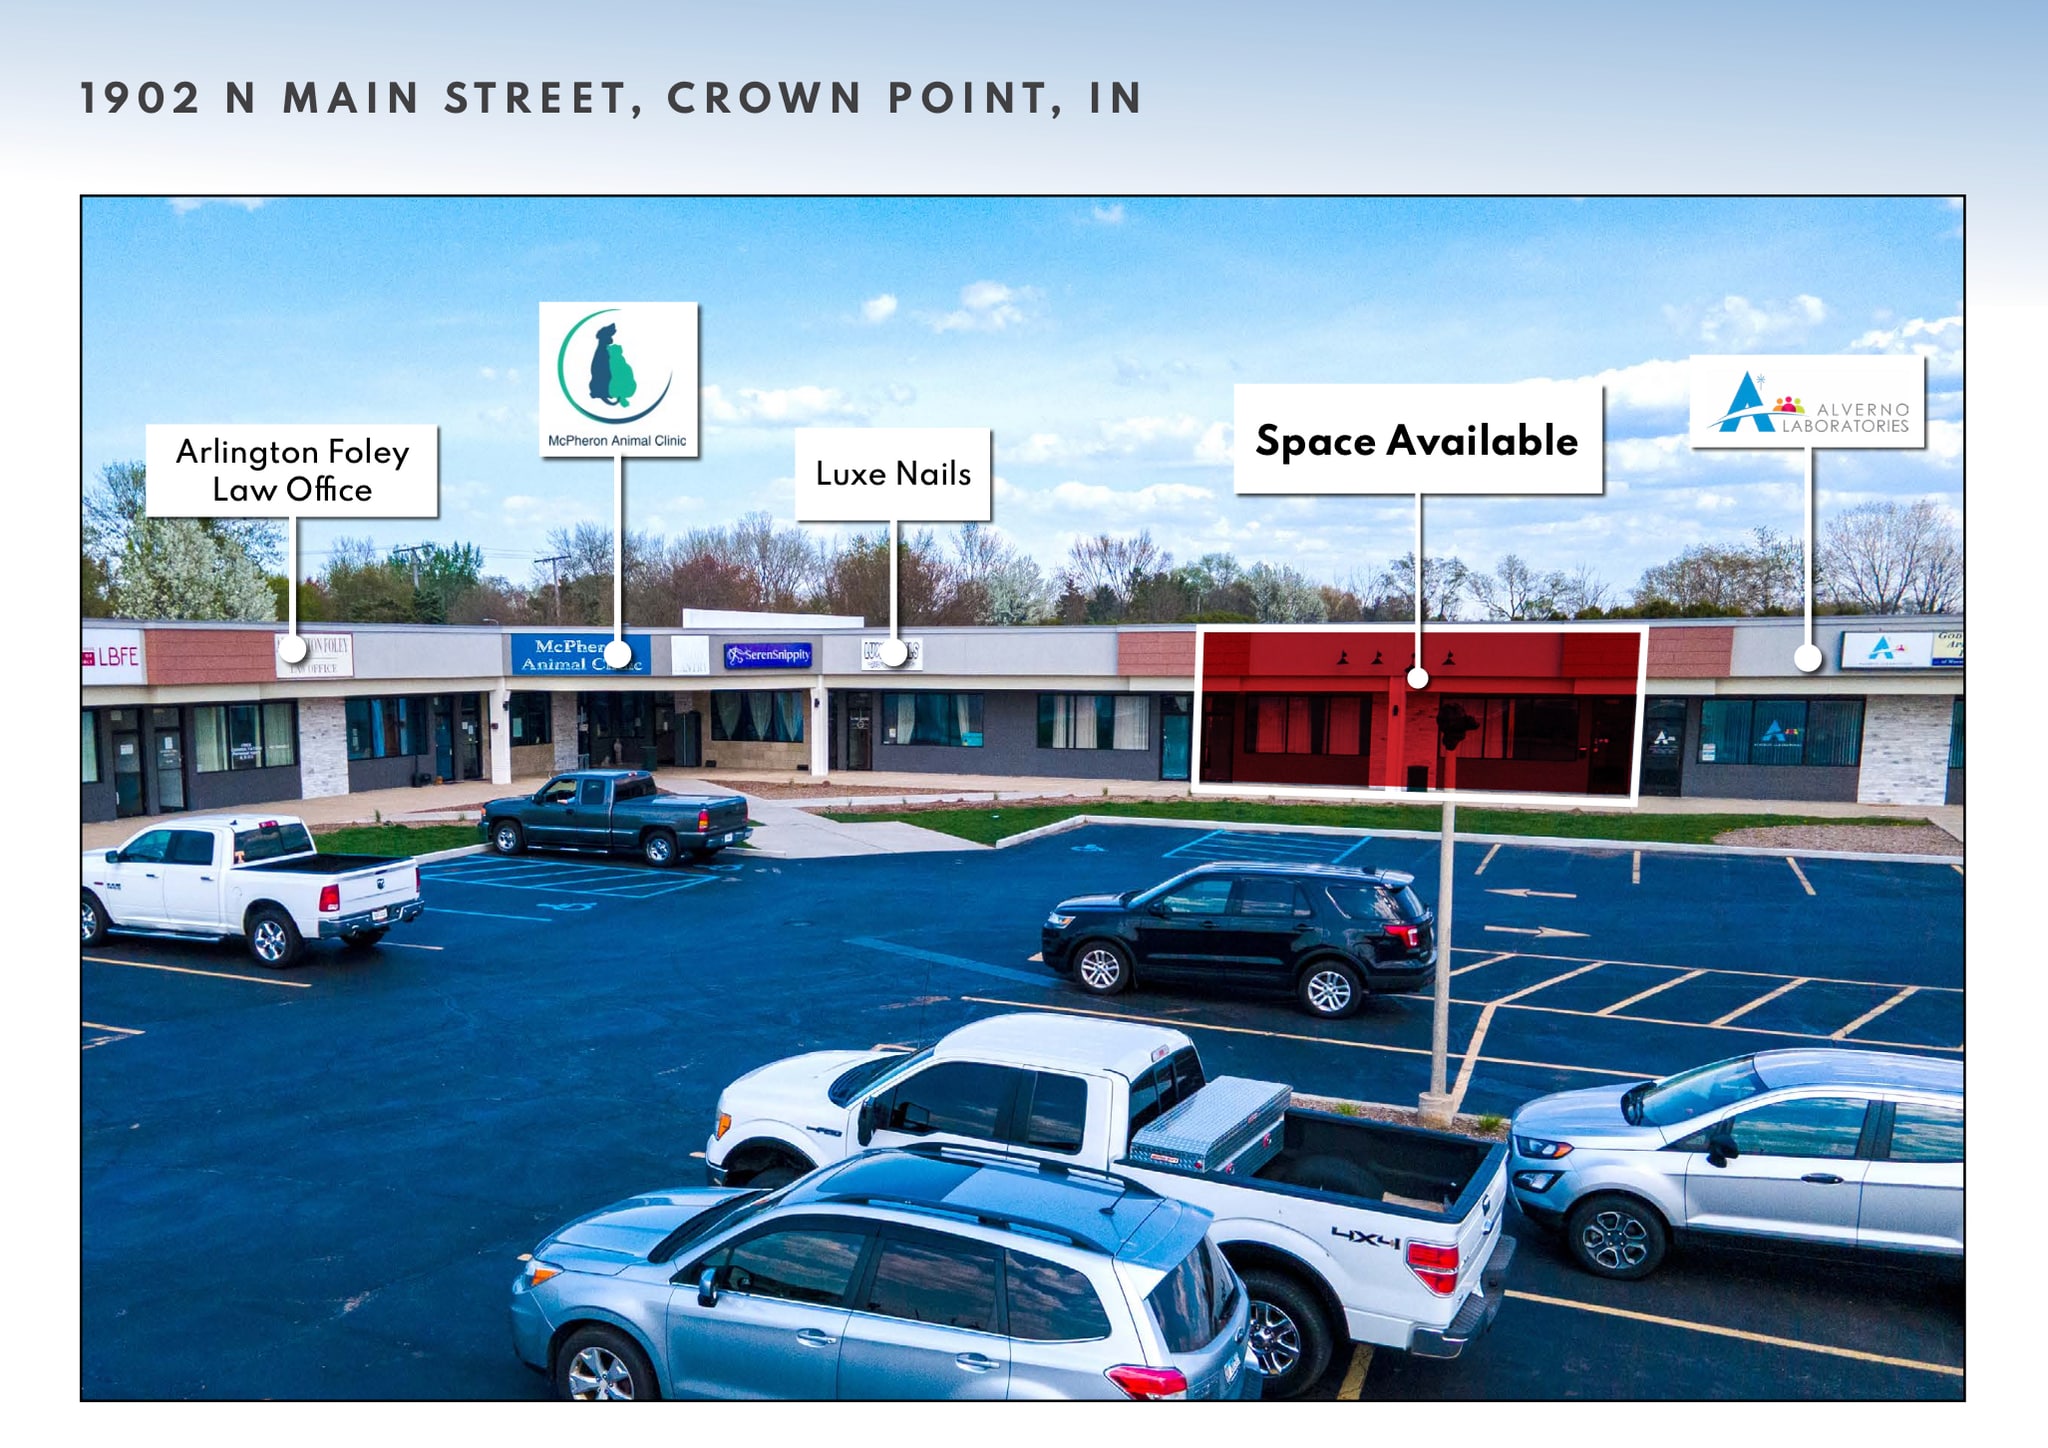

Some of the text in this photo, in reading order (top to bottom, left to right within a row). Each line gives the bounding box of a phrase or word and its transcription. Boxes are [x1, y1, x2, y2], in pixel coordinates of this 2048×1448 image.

[324, 637, 348, 653] FOLEY
[535, 639, 606, 653] McPher
[98, 646, 139, 667] LBFE
[744, 648, 811, 664] SerenSnippity
[307, 664, 338, 674] OFFICE
[521, 658, 588, 671] Animal
[1331, 1226, 1401, 1250] 4X4
